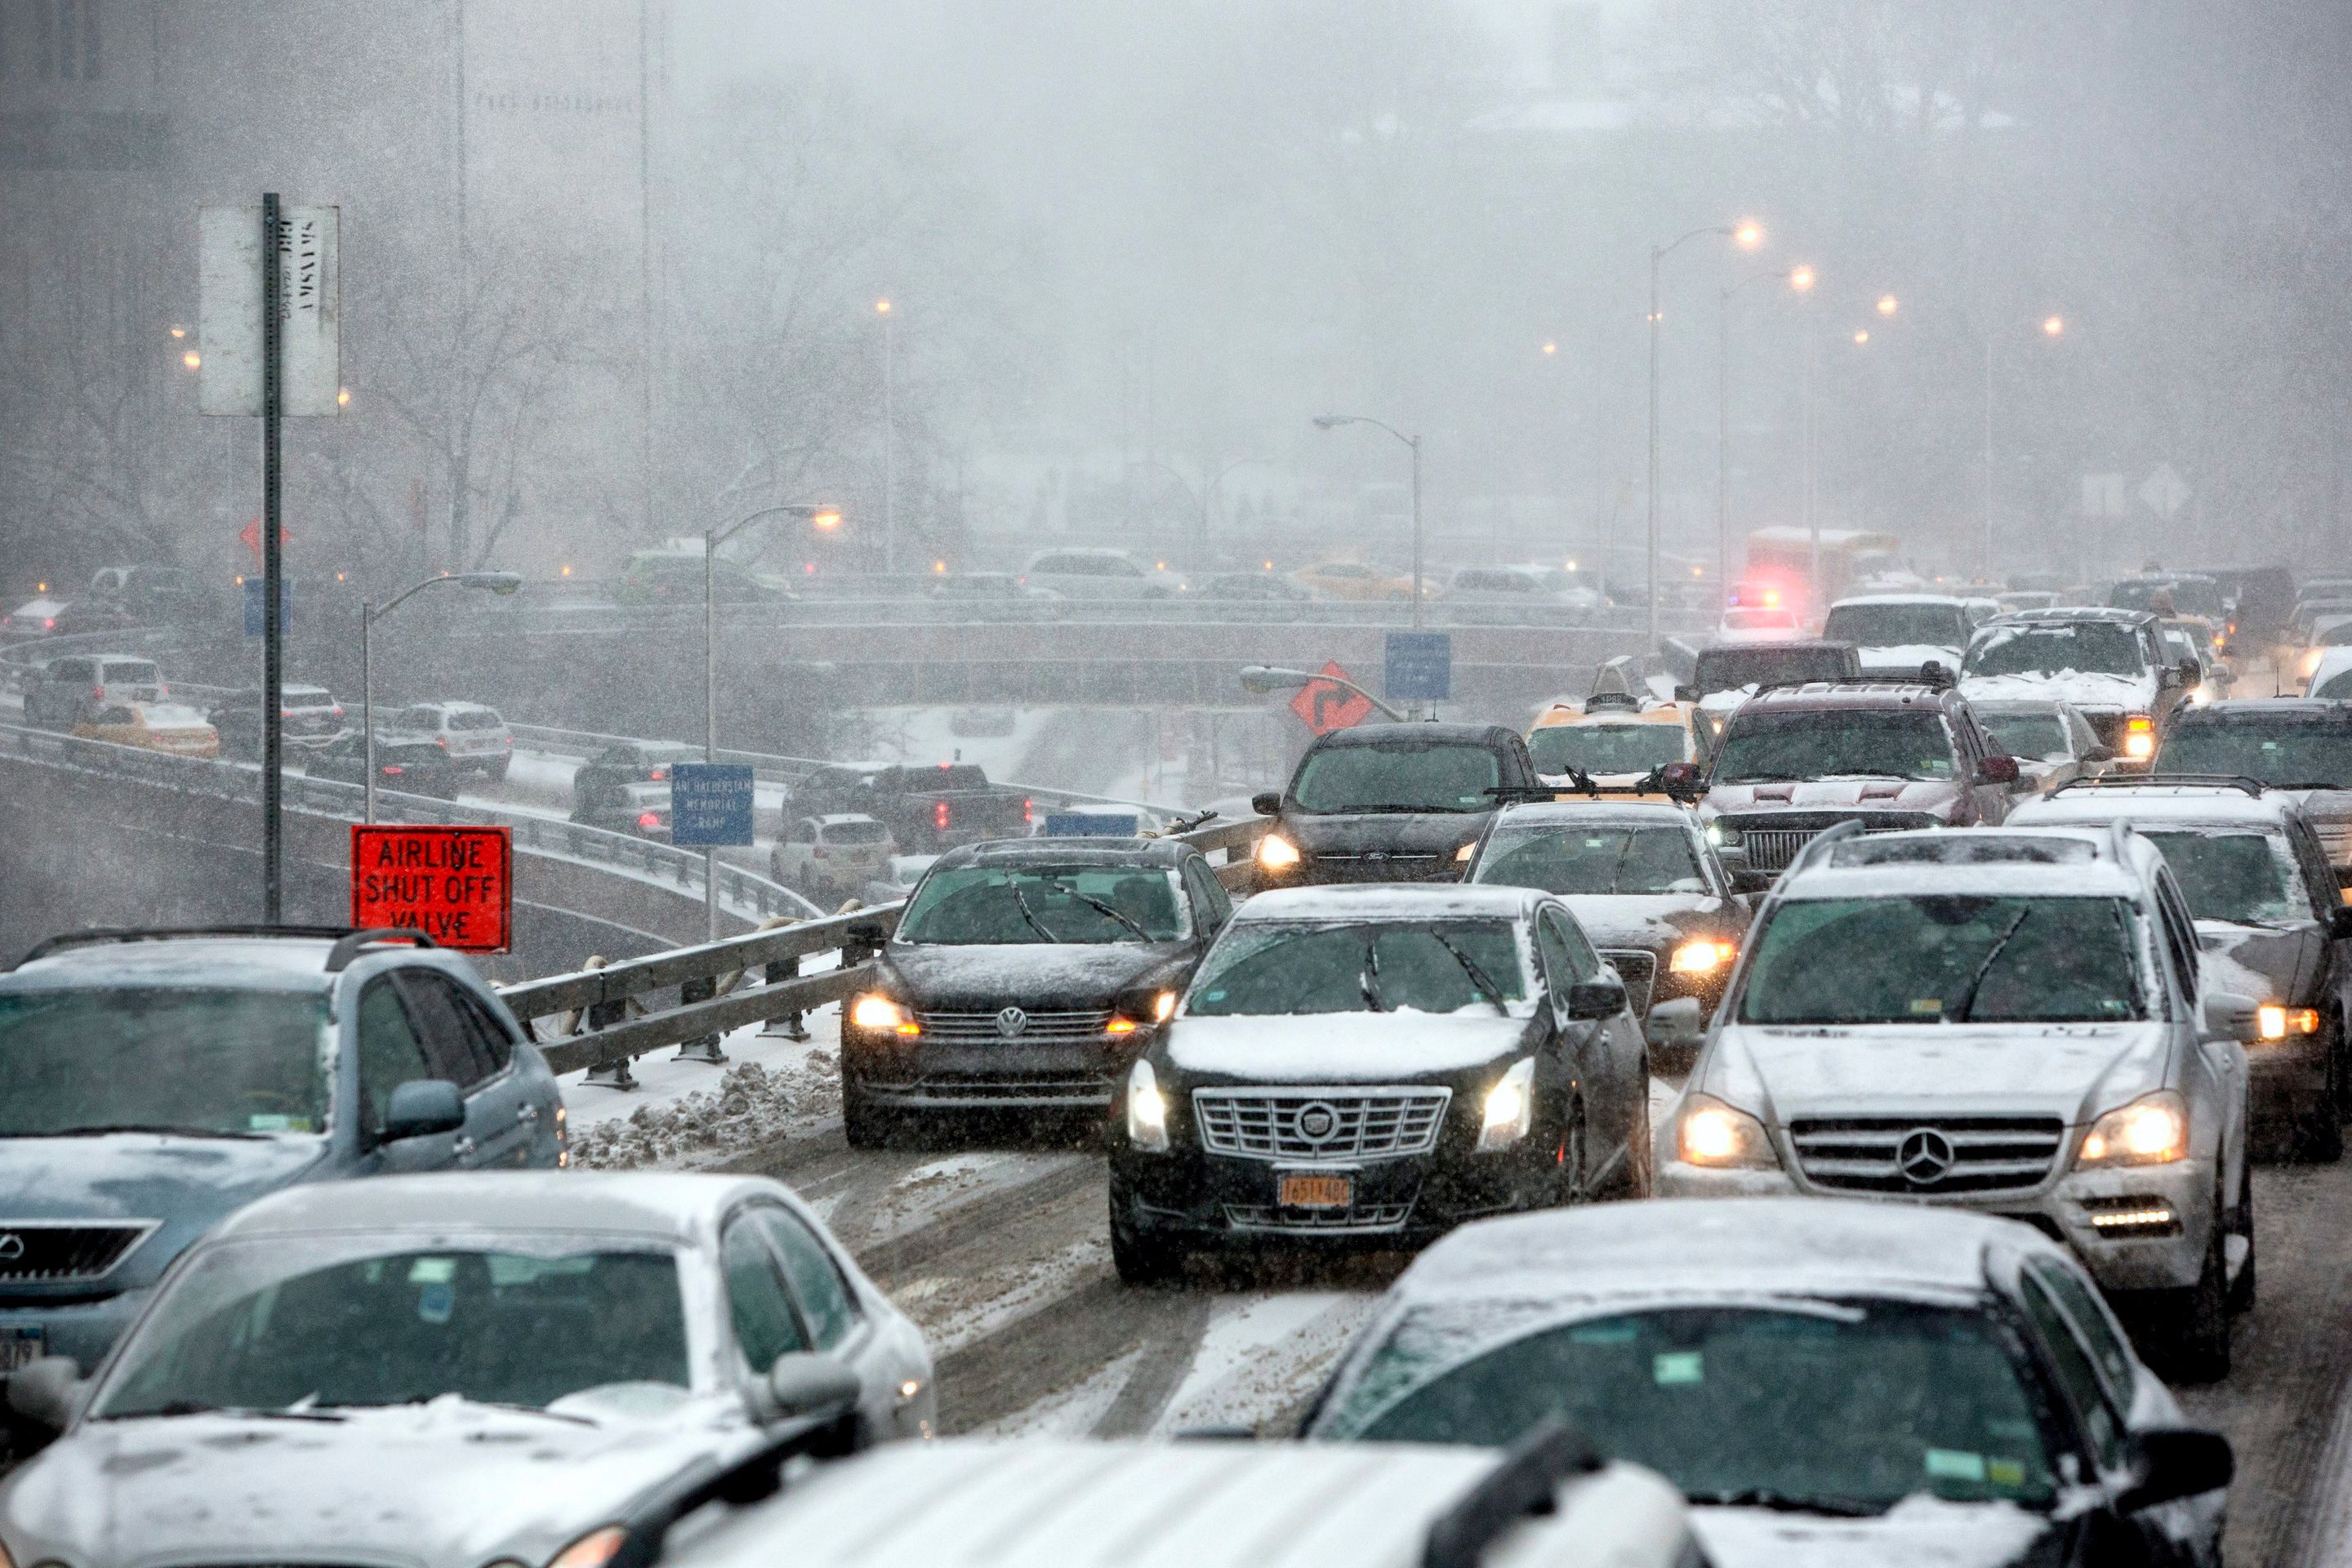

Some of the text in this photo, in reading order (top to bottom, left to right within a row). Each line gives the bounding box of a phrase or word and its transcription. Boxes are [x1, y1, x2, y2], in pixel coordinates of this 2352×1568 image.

[377, 840, 484, 869] AIRLINE
[365, 874, 496, 903] SHUT OFF
[390, 911, 471, 940] VALVE
